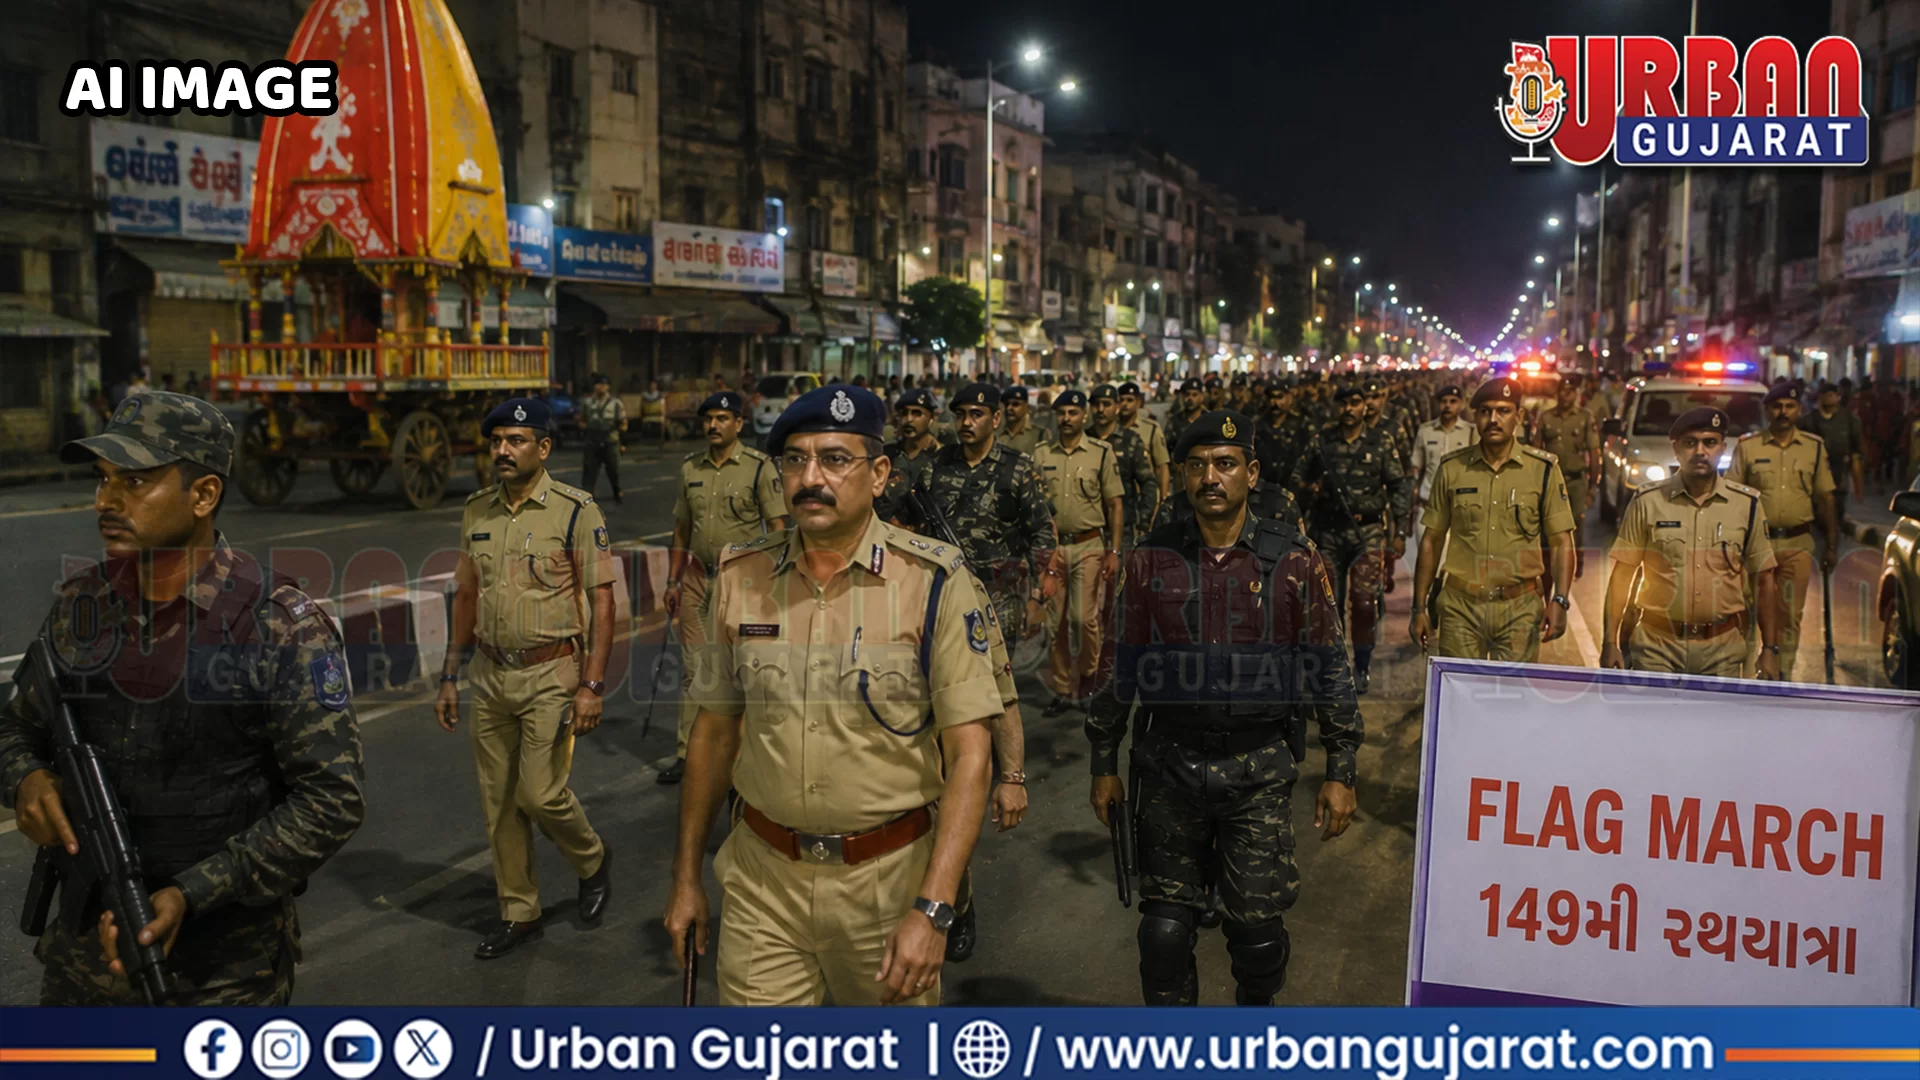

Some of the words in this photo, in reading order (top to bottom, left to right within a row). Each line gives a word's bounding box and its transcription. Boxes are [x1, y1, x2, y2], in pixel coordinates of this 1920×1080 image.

[1467, 777, 1626, 855] FLAG
[1648, 794, 1884, 880] MARCH
[1479, 883, 1638, 952] 149મી
[1663, 908, 1857, 975] રથયાત્રા
